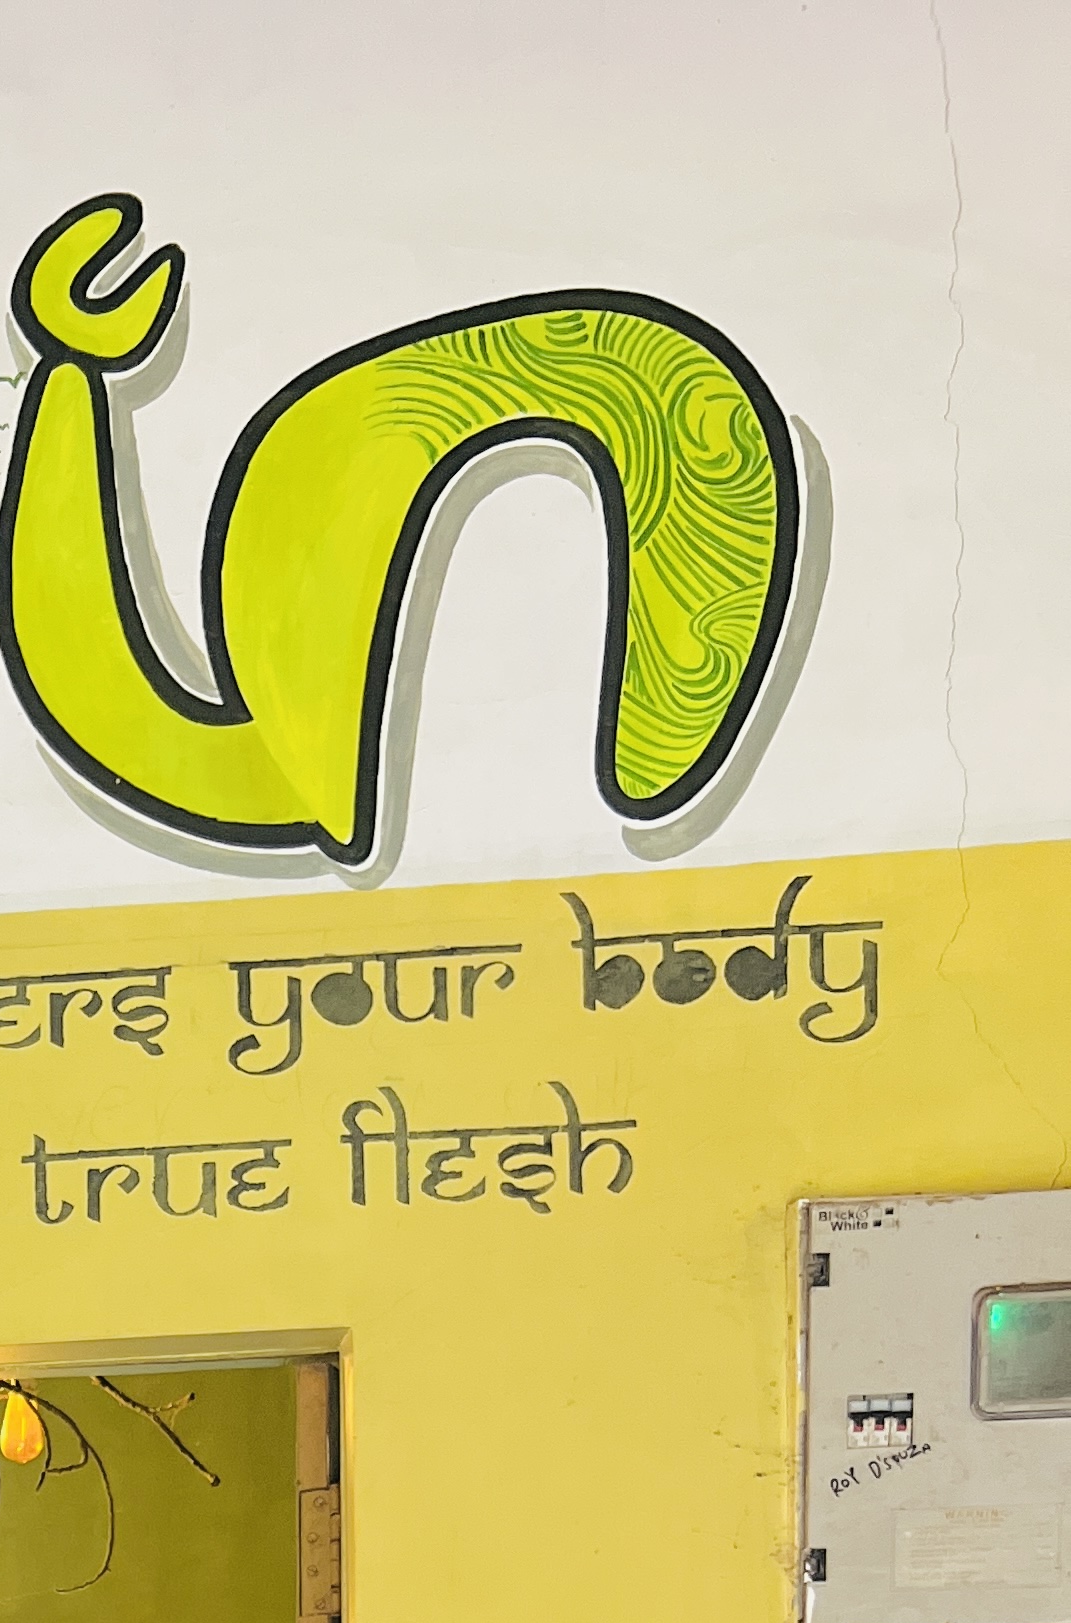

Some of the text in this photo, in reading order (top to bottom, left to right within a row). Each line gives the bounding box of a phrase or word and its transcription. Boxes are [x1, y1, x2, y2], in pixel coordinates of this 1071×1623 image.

[228, 944, 522, 1075] your
[560, 876, 883, 1043] body
[22, 1134, 291, 1225] true
[341, 1082, 636, 1213] flesh
[830, 1220, 868, 1232] White
